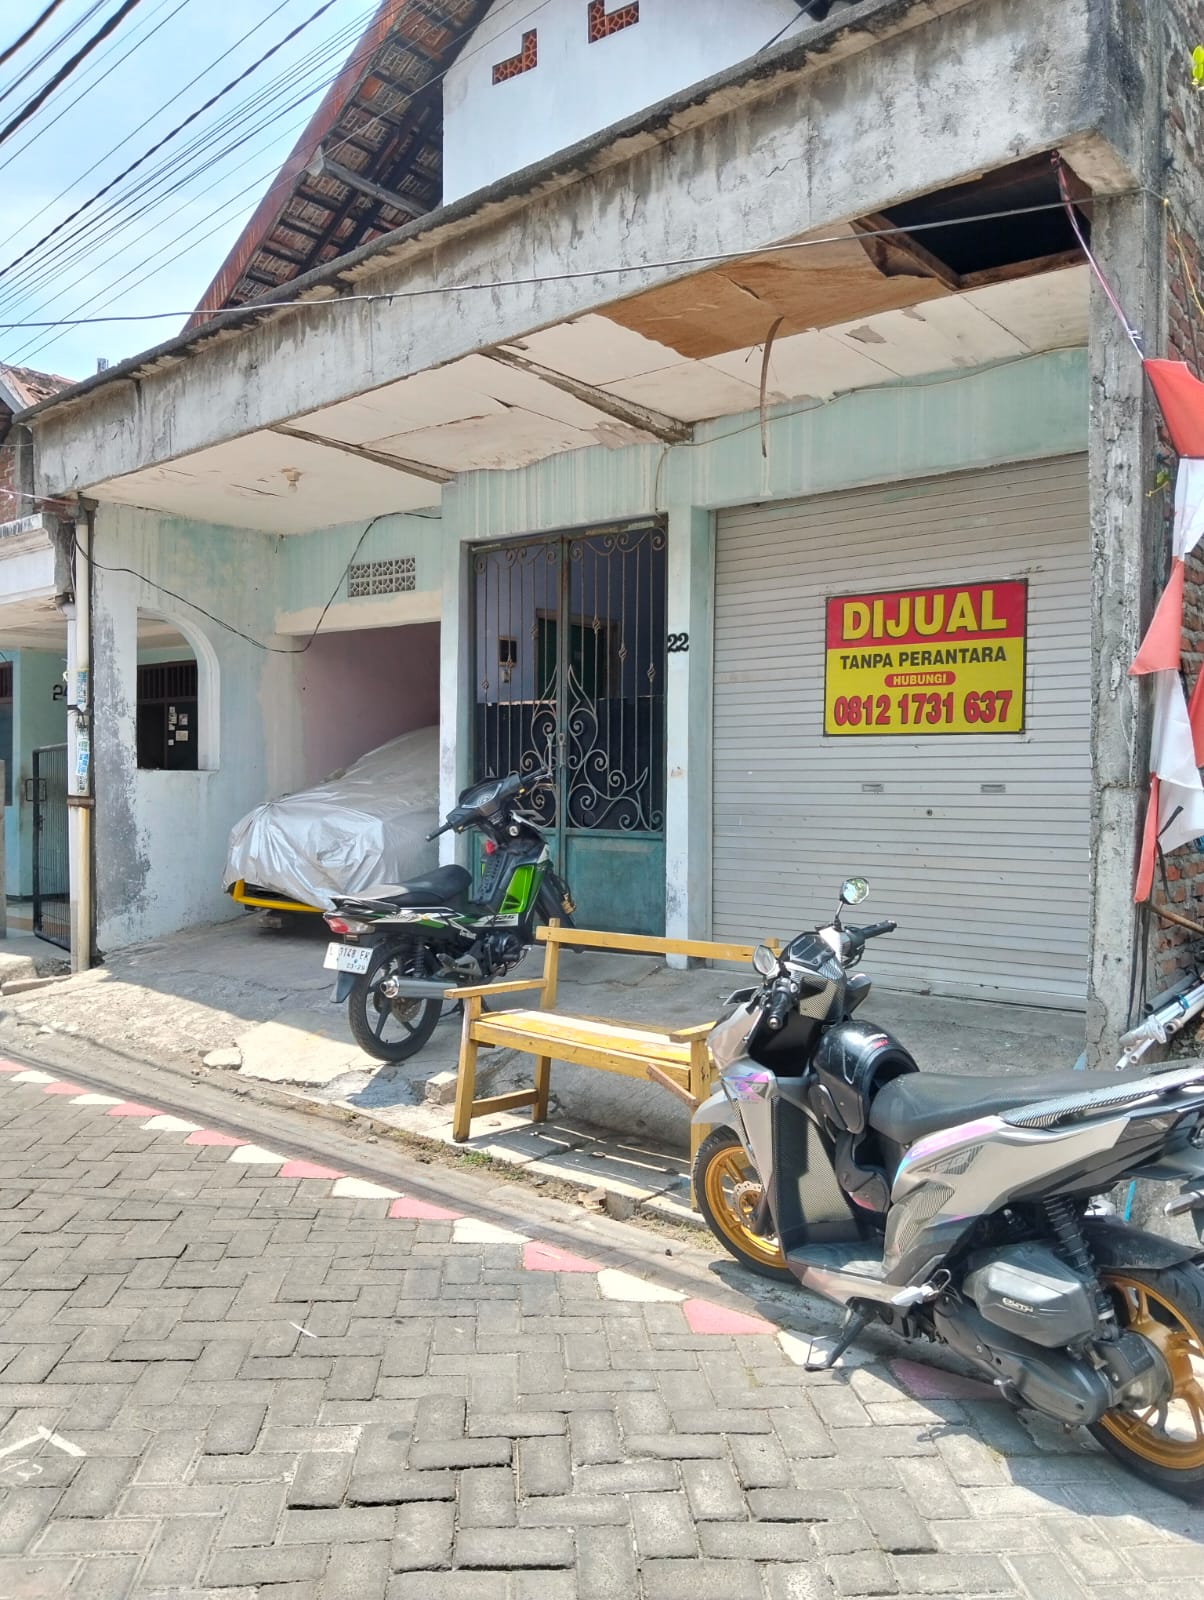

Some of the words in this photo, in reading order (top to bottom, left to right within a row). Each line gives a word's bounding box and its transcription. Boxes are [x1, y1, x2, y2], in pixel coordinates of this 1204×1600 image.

[841, 589, 1008, 642] DIJUAL
[667, 632, 689, 653] 22
[840, 652, 893, 670] TANPA
[899, 646, 1007, 667] PERANTARA
[892, 673, 947, 686] HUBUNGI
[833, 693, 891, 726] 0812
[897, 691, 955, 725] 1731
[963, 689, 1013, 723] 637
